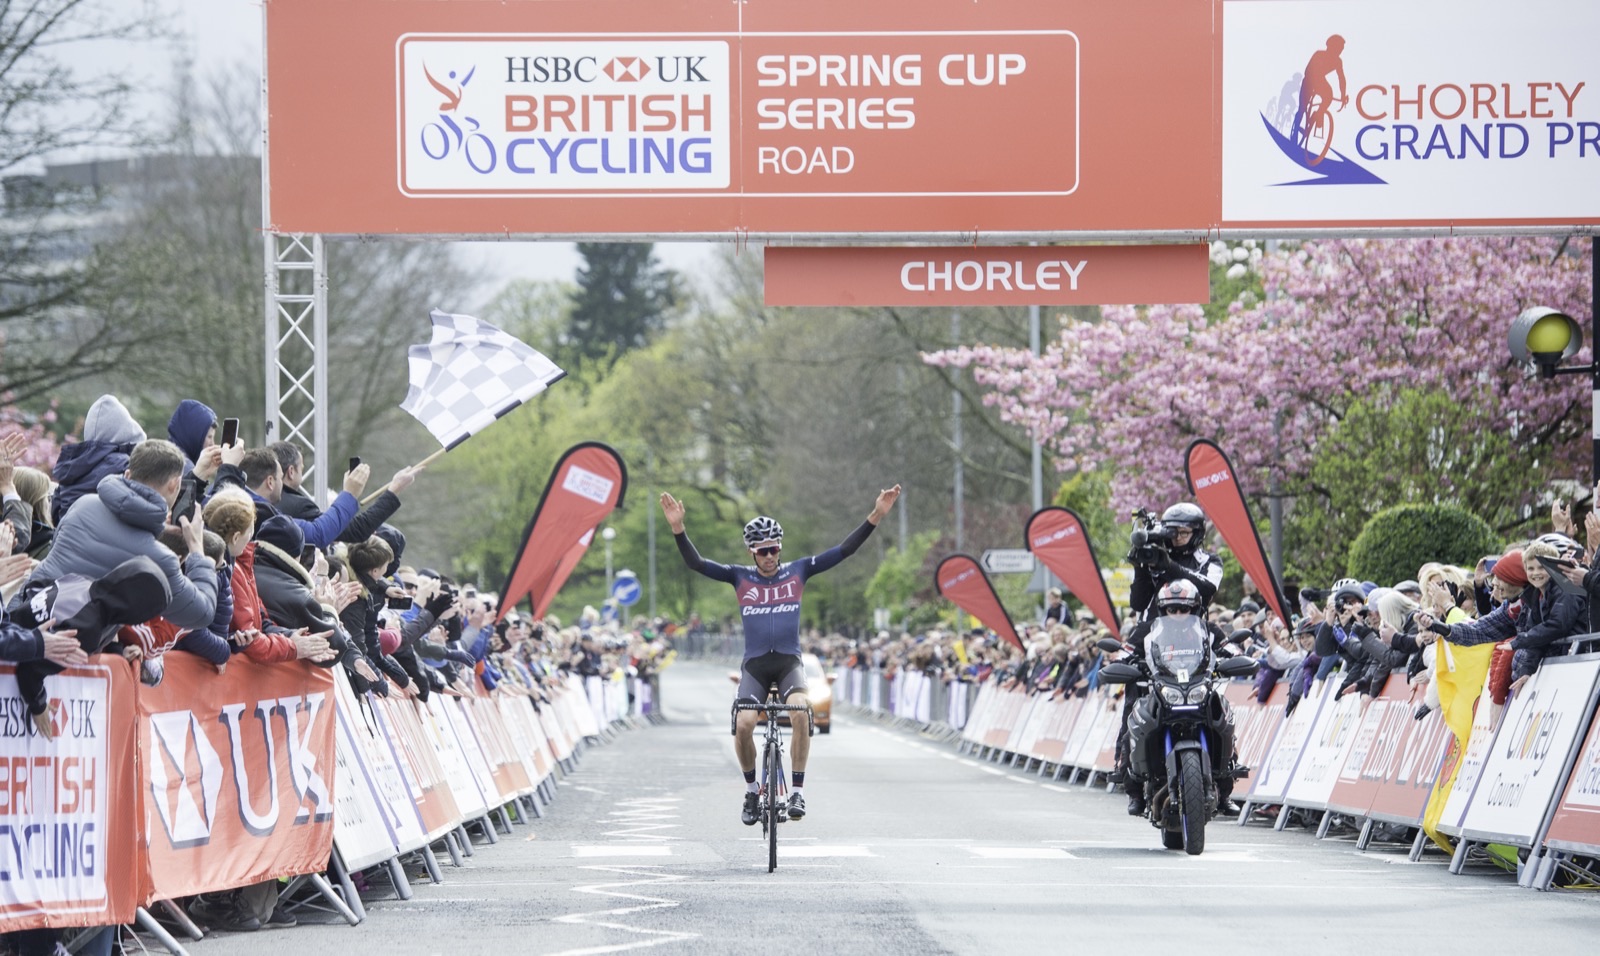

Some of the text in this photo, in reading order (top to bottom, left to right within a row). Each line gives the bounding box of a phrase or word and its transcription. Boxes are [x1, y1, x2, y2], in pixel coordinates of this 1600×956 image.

[505, 56, 711, 83] HSBC UK
[757, 53, 1027, 87] SPRING CUP
[505, 94, 711, 132] BRITISH
[757, 97, 916, 130] SERIES
[1355, 82, 1586, 121] CHORLEY
[505, 138, 712, 174] CYCLING
[1355, 123, 1530, 161] GRAND
[758, 146, 855, 175] ROAD
[900, 260, 1088, 292] CHORLEY
[760, 580, 796, 604] JLT
[742, 603, 799, 616] Condor
[70, 699, 96, 738] UK
[219, 692, 333, 835] UK
